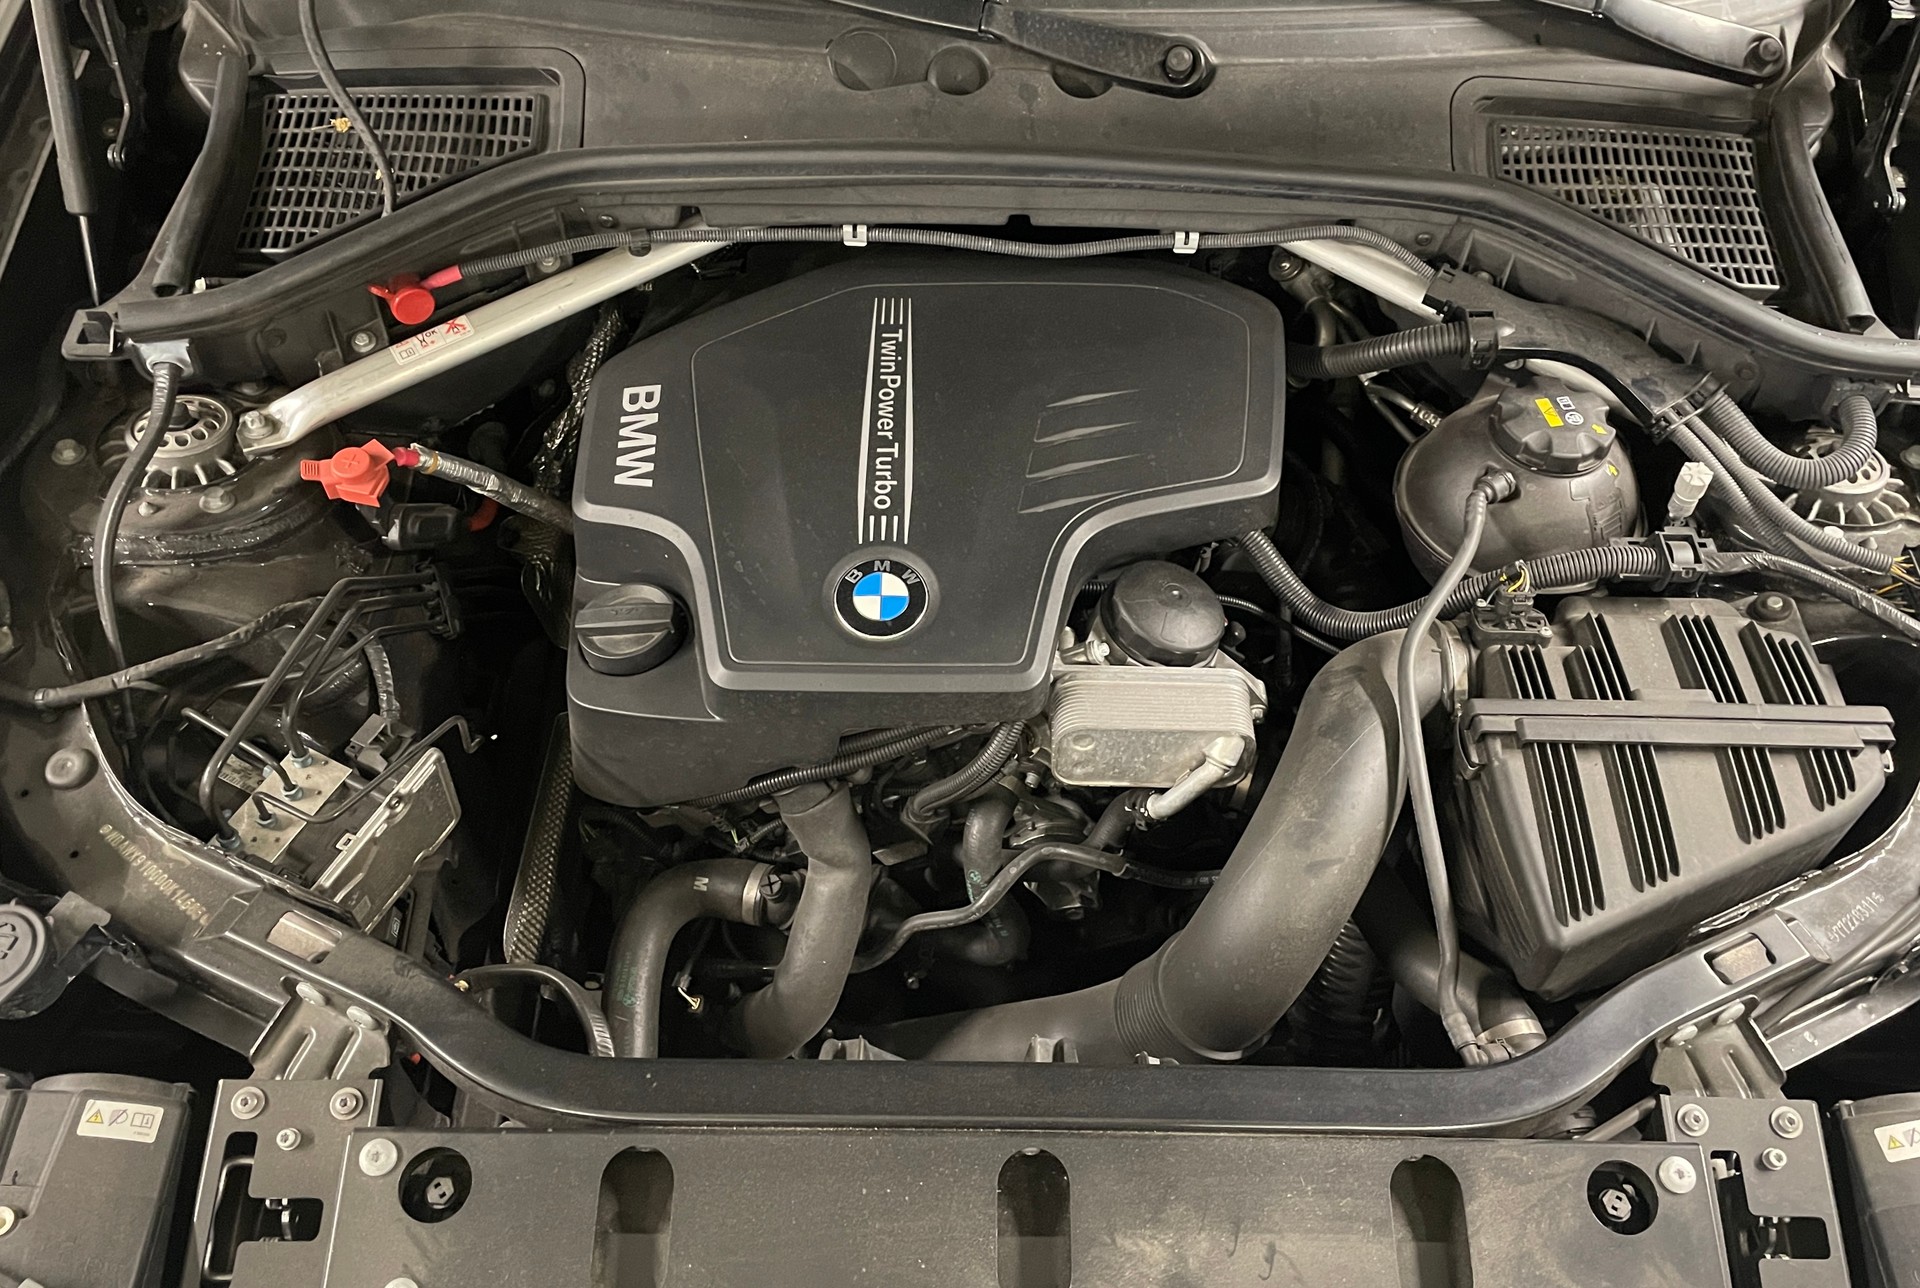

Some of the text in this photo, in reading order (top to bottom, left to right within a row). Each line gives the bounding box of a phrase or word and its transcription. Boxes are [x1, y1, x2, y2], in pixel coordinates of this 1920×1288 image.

[613, 384, 662, 488] BMW
[873, 328, 903, 510] TwinPower Turbo
[844, 560, 920, 585] BMW
